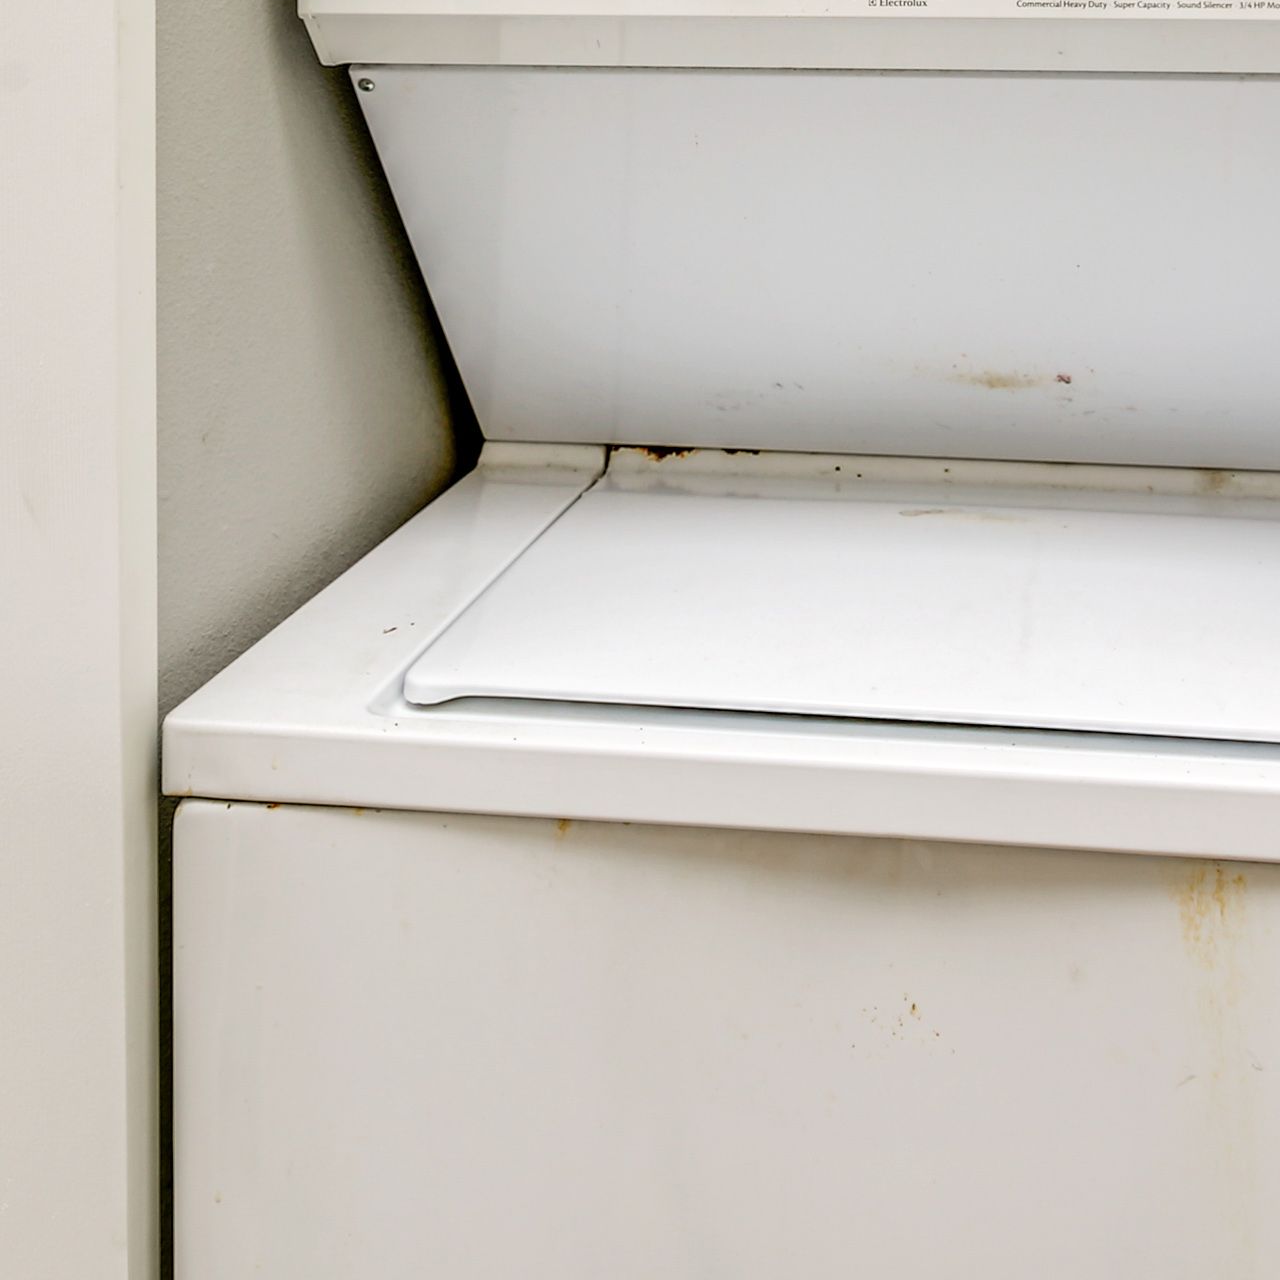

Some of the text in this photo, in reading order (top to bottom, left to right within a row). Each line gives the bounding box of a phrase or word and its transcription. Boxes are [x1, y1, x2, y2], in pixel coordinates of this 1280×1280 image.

[1016, 0, 1062, 8] Commercial
[1064, 0, 1086, 9] Heavy
[1088, 1, 1107, 9] Duty
[1114, 1, 1135, 9] Super
[1137, 1, 1170, 9] Capacity
